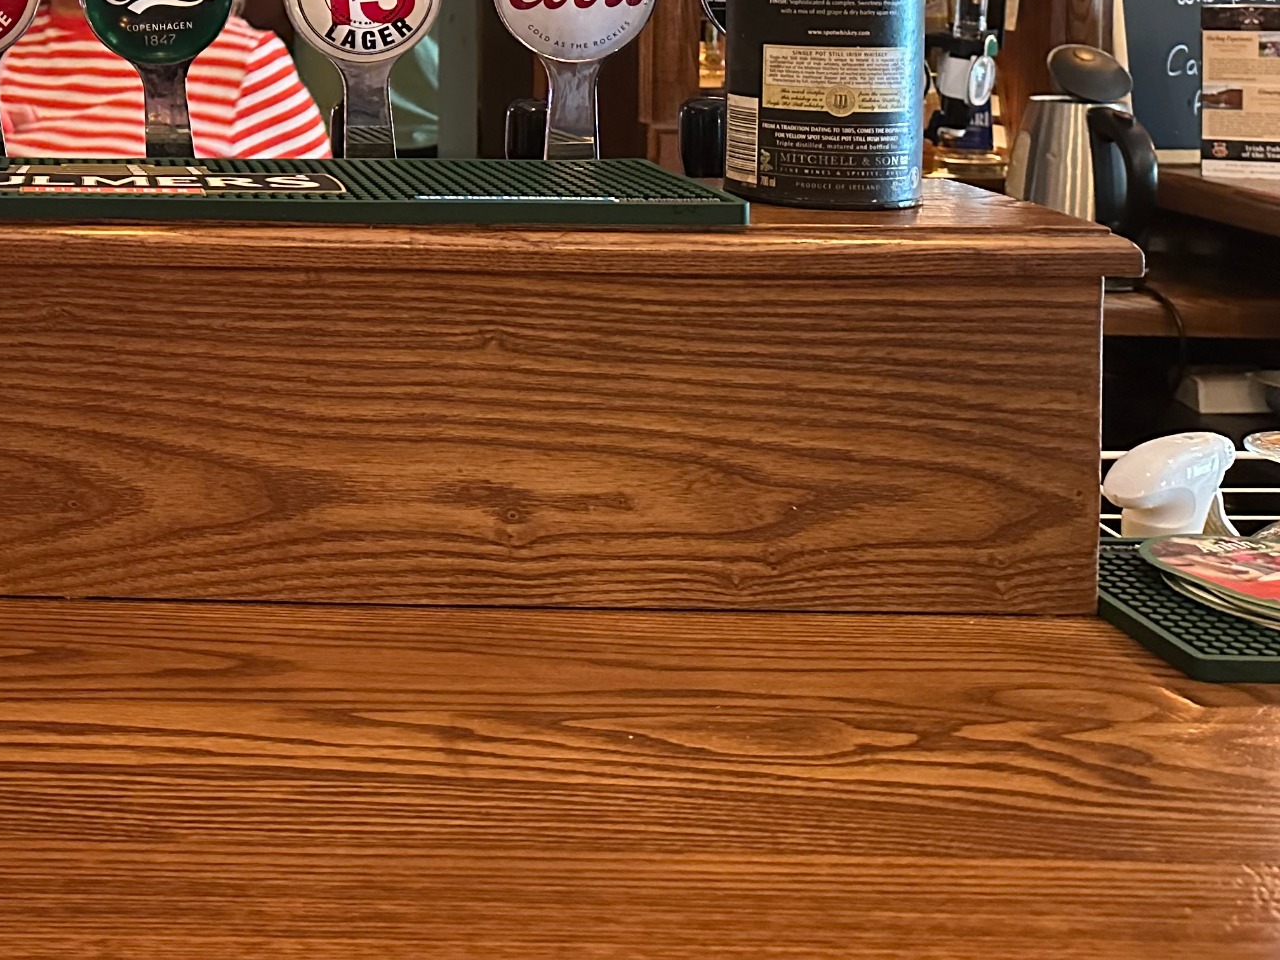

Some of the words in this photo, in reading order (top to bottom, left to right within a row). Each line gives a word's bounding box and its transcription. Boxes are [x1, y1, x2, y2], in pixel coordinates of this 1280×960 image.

[127, 21, 193, 32] COPENHAGEN
[144, 33, 176, 46] 1847
[324, 18, 413, 50] LAGER
[527, 24, 550, 42] COLD
[593, 20, 630, 47] ROCKIES
[781, 124, 810, 132] TRADITION
[810, 125, 832, 133] DATING
[776, 140, 794, 148] Triple
[796, 141, 824, 149] distilled,
[827, 142, 854, 150] matured
[780, 152, 857, 165] MITCHELL
[862, 157, 870, 165] &
[795, 181, 832, 190] PRODUCT
[835, 182, 846, 190] OF
[849, 183, 880, 191] IRELAND
